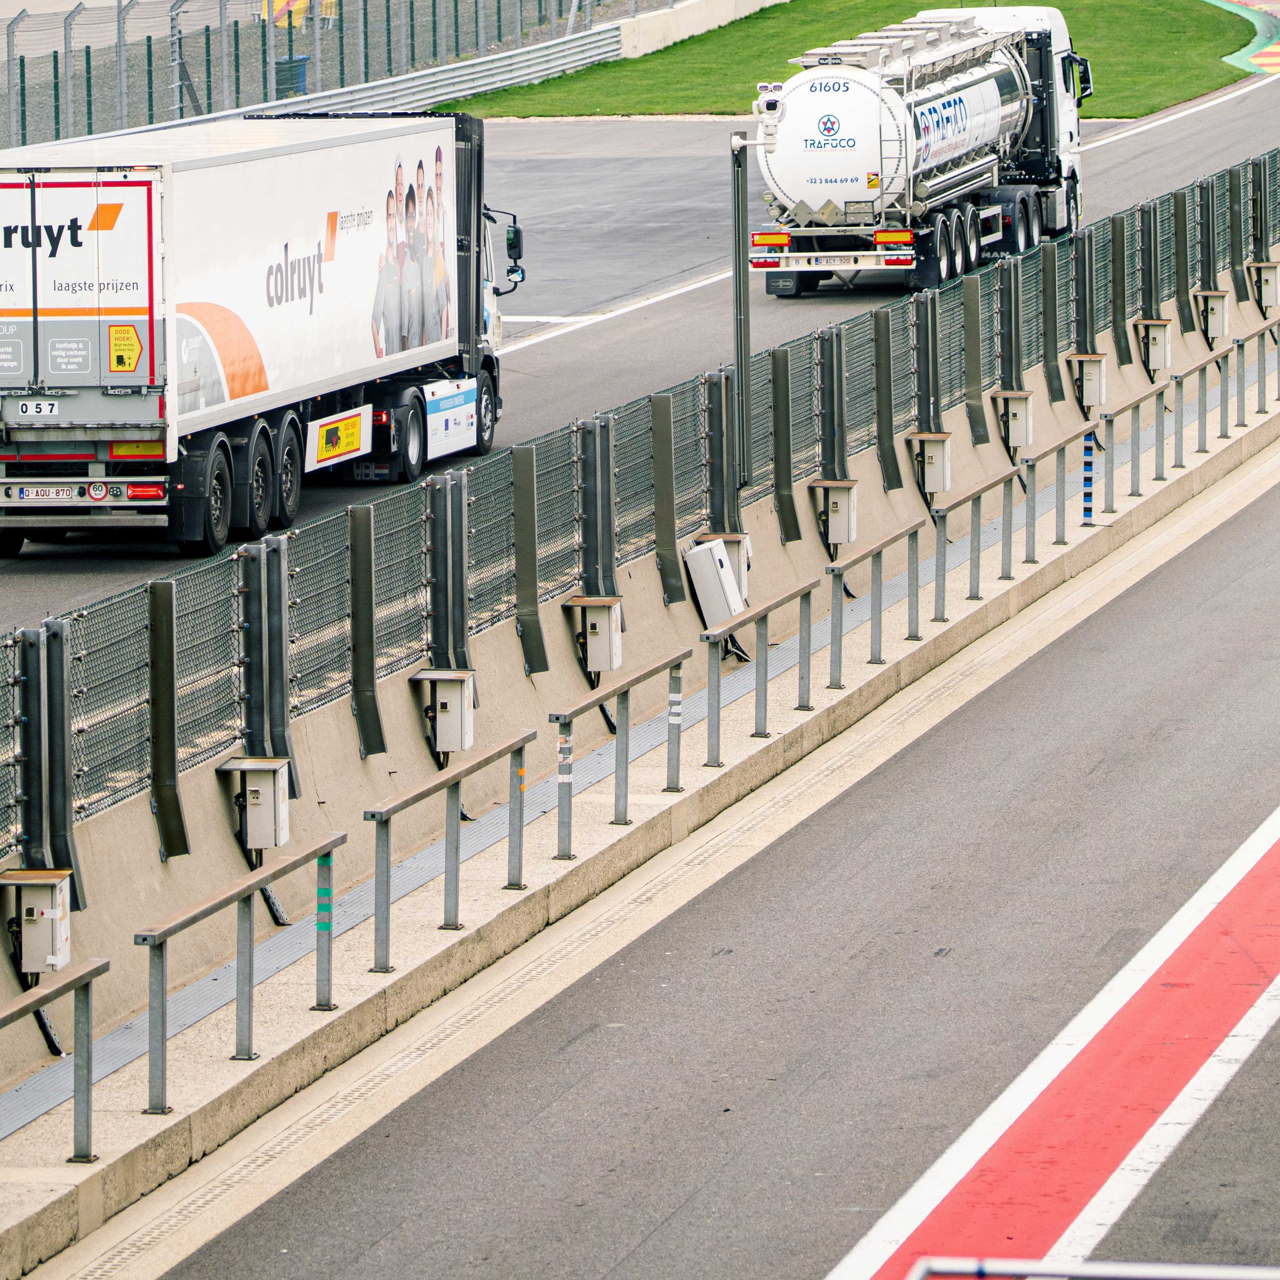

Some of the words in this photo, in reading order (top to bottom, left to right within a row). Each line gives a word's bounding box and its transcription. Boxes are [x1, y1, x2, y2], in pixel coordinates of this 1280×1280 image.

[809, 81, 850, 93] 61605
[266, 239, 324, 316] colruyt
[53, 280, 94, 295] laagste
[98, 279, 139, 294] prijzen
[92, 484, 103, 493] 60
